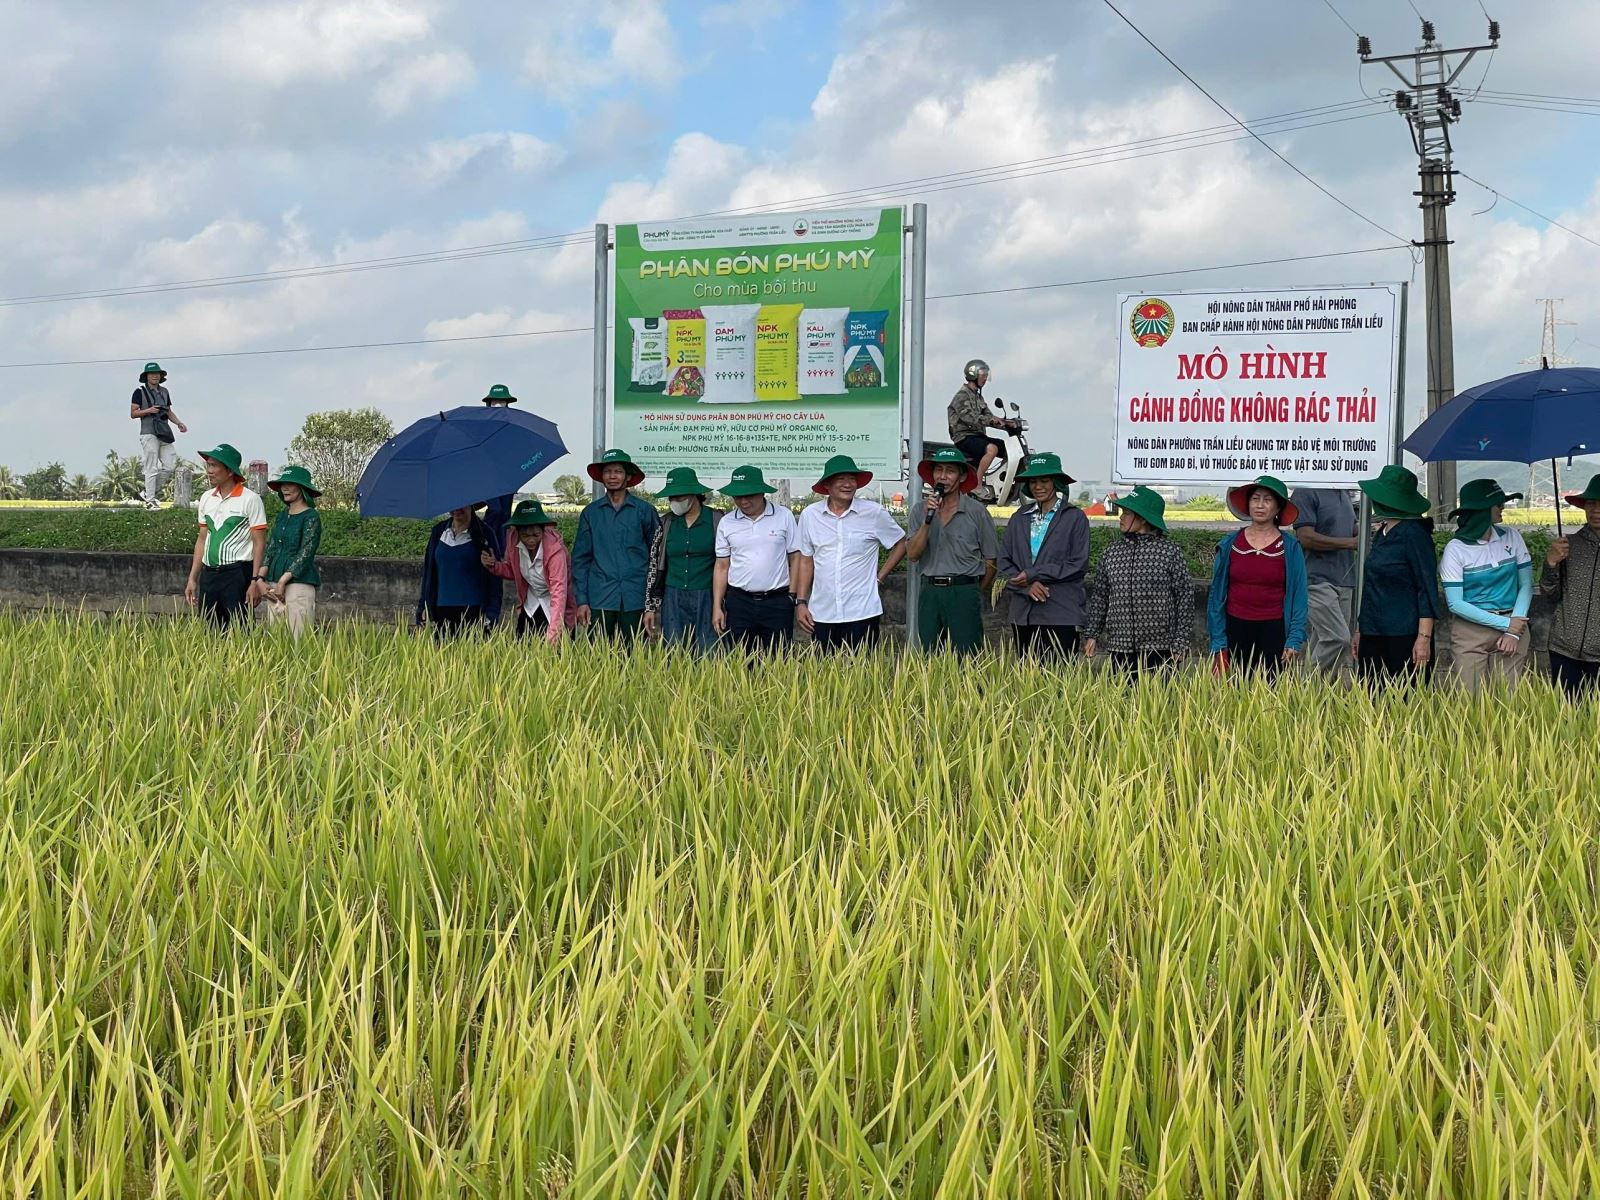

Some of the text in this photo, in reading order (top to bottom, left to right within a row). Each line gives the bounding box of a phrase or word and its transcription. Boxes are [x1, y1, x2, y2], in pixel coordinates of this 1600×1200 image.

[640, 247, 876, 279] PHÂN BÓN PHÚ MỸ
[694, 278, 816, 297] Cho mùa bội thu
[1208, 296, 1357, 316] HỘI NÔNG DÂN THÀNH PHỐ HẢI PHÒNG
[758, 324, 778, 332] NPK
[1182, 322, 1198, 332] BAN
[1200, 317, 1220, 332] CHẤP
[1222, 318, 1244, 332] HÀNH
[1246, 318, 1260, 333] HỘI
[1262, 318, 1284, 331] NÔNG
[1286, 317, 1304, 330] DÂN
[1306, 316, 1338, 330] PHƯỜNG
[677, 350, 684, 364] 3
[1177, 344, 1328, 380] MÔ HÌNH
[1130, 388, 1376, 422] CÁNH ĐỒNG KHÔNG RÁC THẢI
[794, 412, 808, 420] CÂY
[810, 412, 825, 420] LÚA
[644, 423, 658, 432] SẢN
[684, 425, 698, 434] ĐẠM
[678, 444, 708, 452] PHƯỜNG
[752, 444, 776, 452] THÀNH
[778, 444, 793, 452] PHỐ
[794, 444, 808, 452] HẢI
[810, 444, 836, 452] PHÒNG
[1128, 436, 1149, 450] NÔNG
[1151, 436, 1167, 450] DÂN
[1169, 436, 1200, 450] PHƯỜNG
[1246, 438, 1274, 451] CHUNG
[1276, 439, 1290, 451] TAY
[1292, 436, 1308, 452] BẢO
[1311, 438, 1320, 454] VỆ
[1324, 438, 1340, 452] MÔI
[1342, 437, 1376, 452] TRƯỜNG
[1134, 458, 1148, 468] THU
[1150, 458, 1168, 468] GOM
[1170, 458, 1185, 468] BAO
[1200, 455, 1210, 470] VỎ
[1212, 455, 1238, 470] THUỐC
[1240, 455, 1256, 470] BẢO
[1258, 457, 1268, 472] VỆ
[1270, 458, 1292, 472] THỰC
[1294, 456, 1310, 473] VẬT
[1312, 459, 1328, 471] SAU
[1331, 456, 1344, 472] SỬ
[1344, 460, 1368, 474] DỤNG
